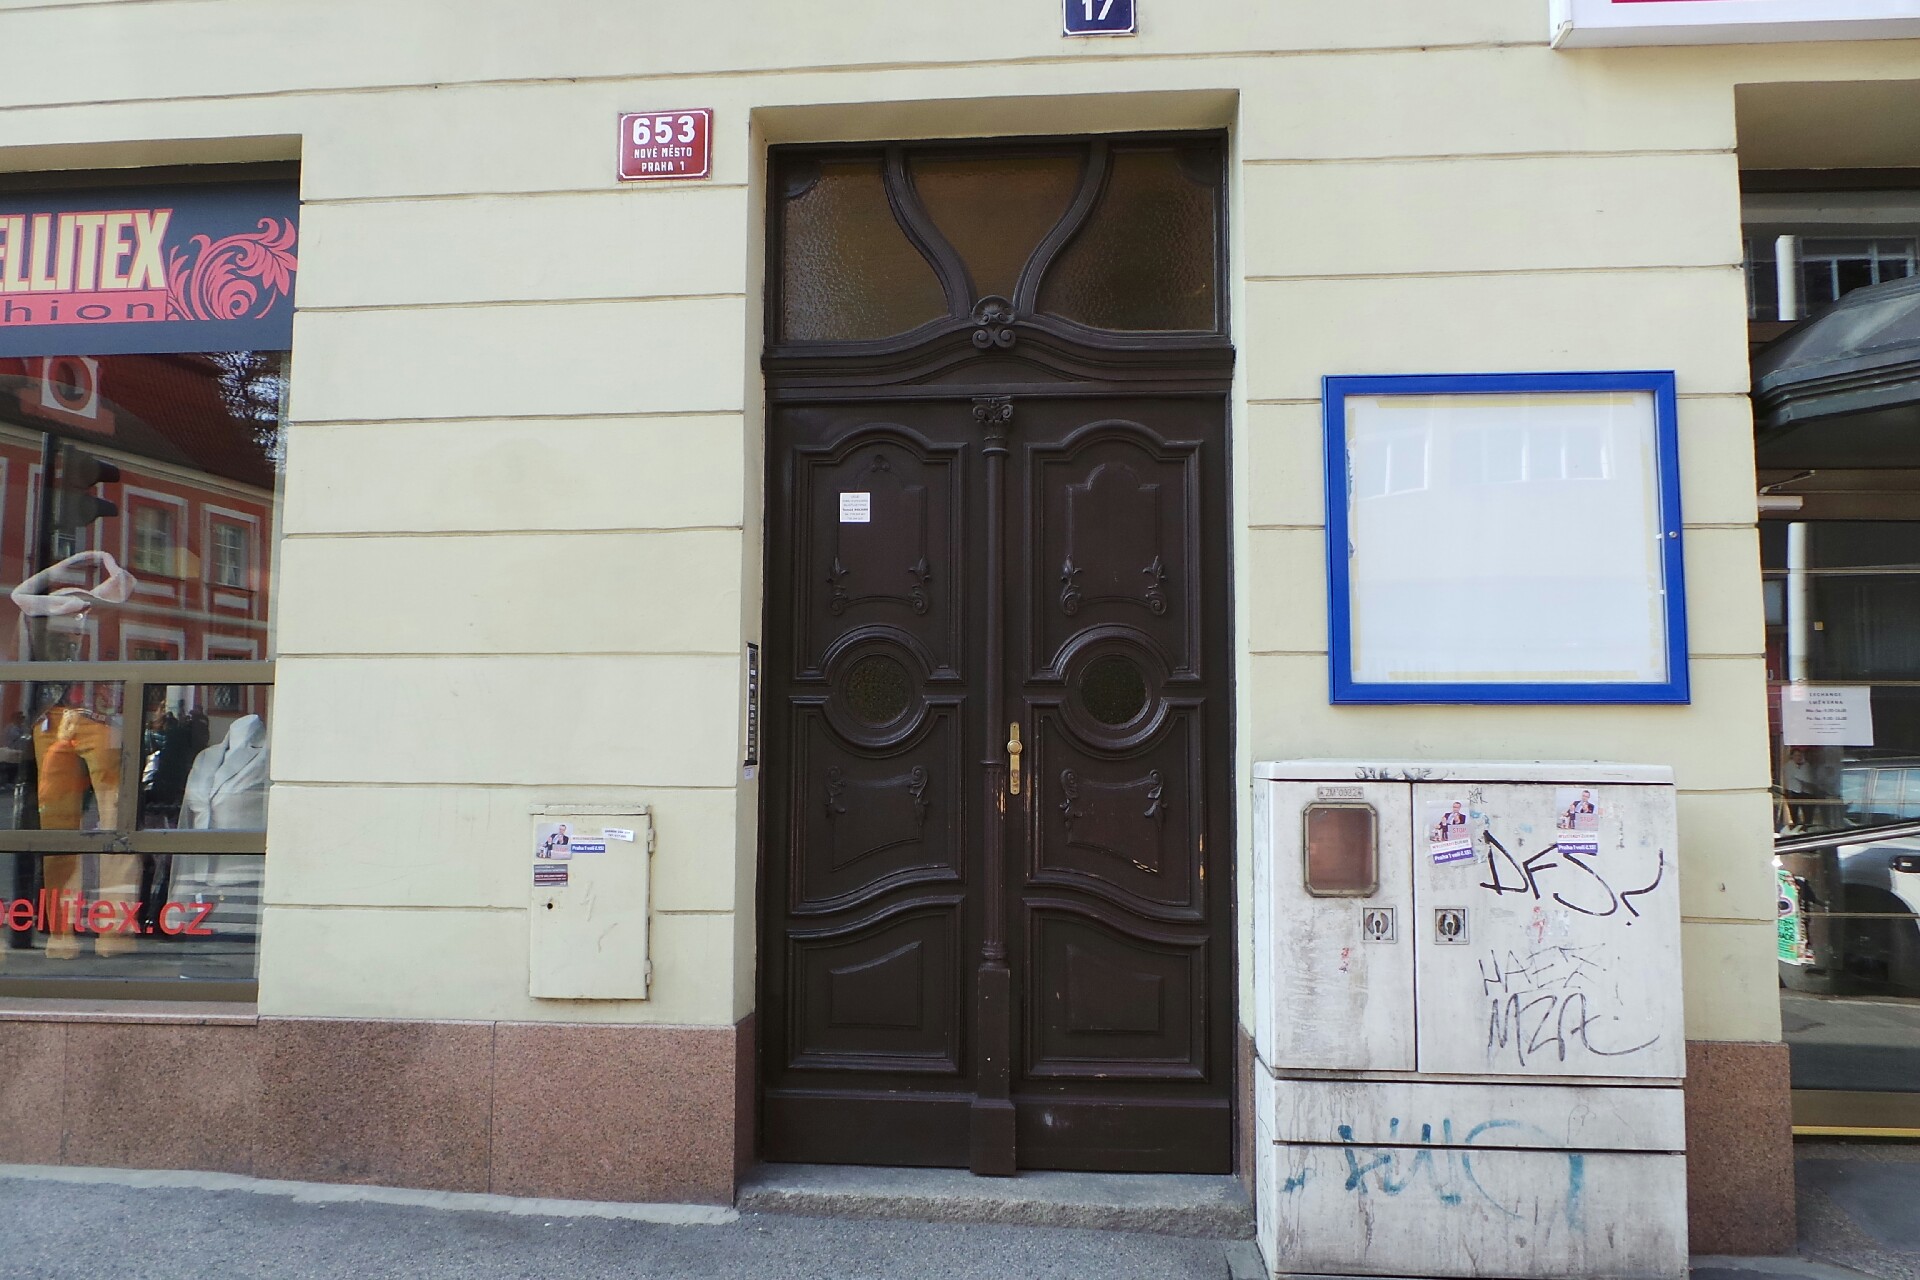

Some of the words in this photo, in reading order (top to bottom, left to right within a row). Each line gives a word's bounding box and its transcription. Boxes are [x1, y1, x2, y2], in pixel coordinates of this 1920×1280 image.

[1081, 0, 1114, 21] 17
[632, 115, 696, 145] 653
[634, 145, 658, 159] NOVÉ
[661, 144, 693, 158] MĚSTO
[641, 160, 674, 173] PRAHA
[680, 160, 685, 171] 1
[0, 888, 214, 936] ellitex.cz
